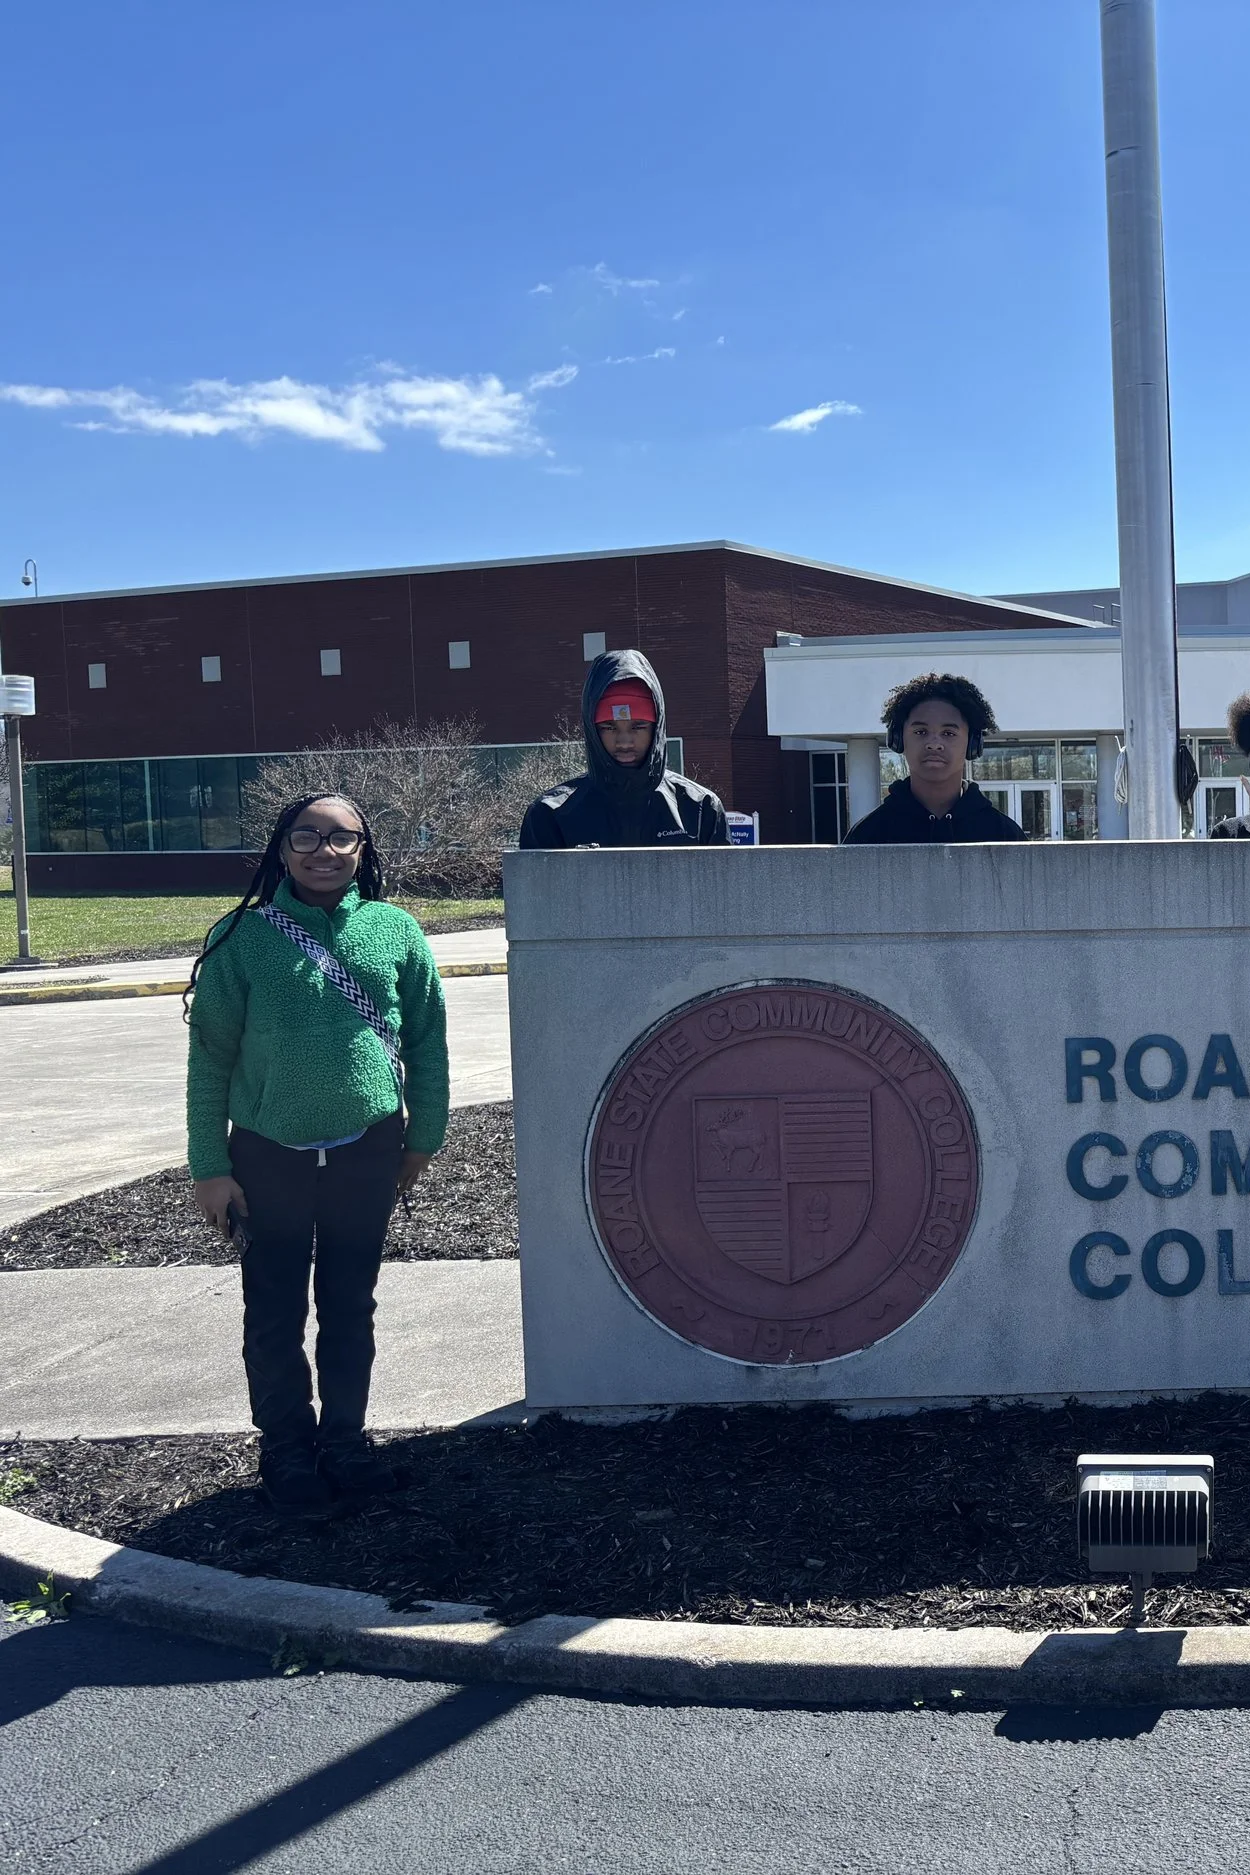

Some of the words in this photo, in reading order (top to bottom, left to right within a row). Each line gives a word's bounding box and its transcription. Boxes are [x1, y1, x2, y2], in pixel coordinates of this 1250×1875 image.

[612, 1031, 698, 1131] STATE
[701, 996, 932, 1081] COMMUNITY
[600, 1142, 660, 1279] ROANE
[909, 1088, 969, 1276] COLLEGE
